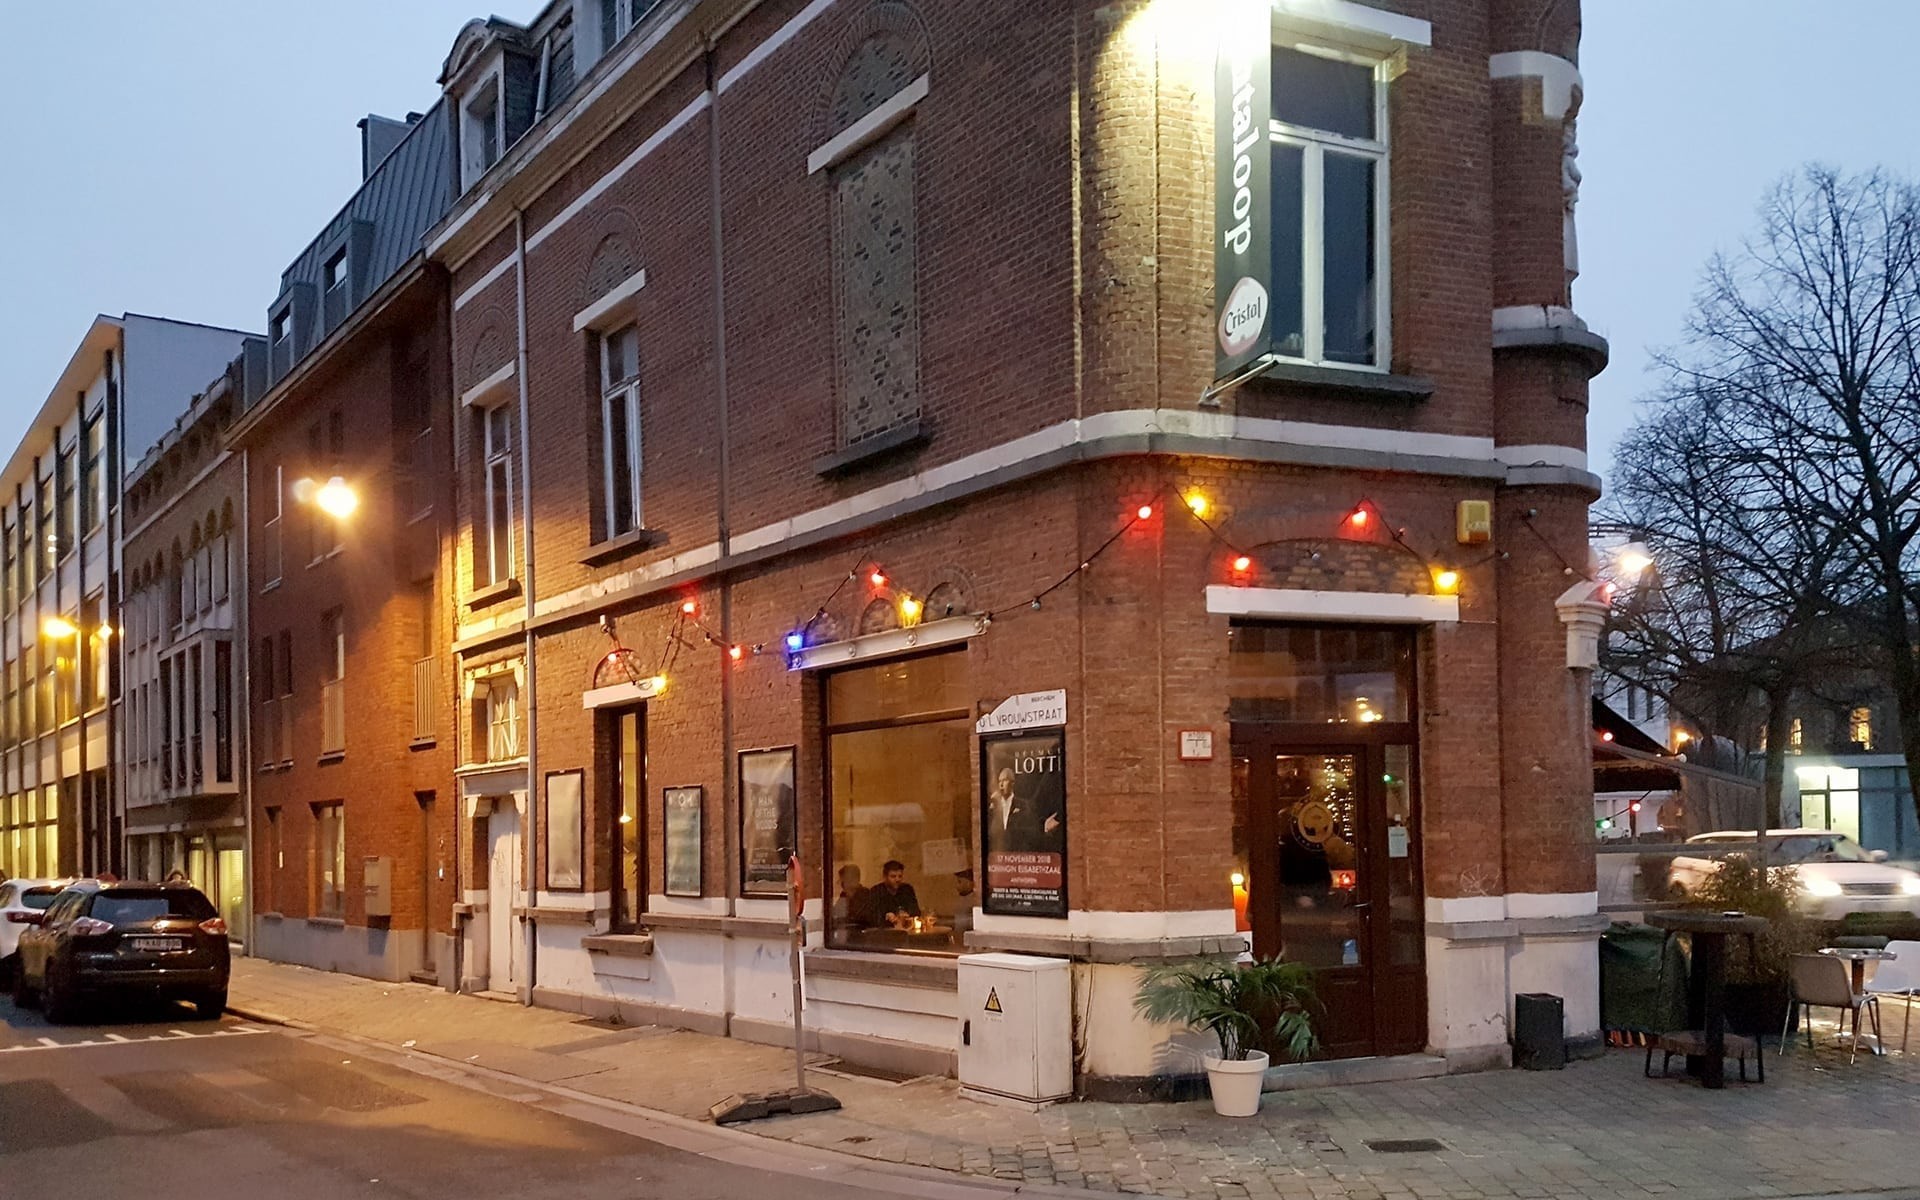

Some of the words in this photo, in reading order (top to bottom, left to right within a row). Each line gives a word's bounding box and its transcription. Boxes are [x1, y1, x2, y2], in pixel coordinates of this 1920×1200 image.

[1224, 60, 1260, 255] taloop
[1224, 296, 1261, 337] Cristal
[996, 708, 1062, 727] VROUWSTRAAT
